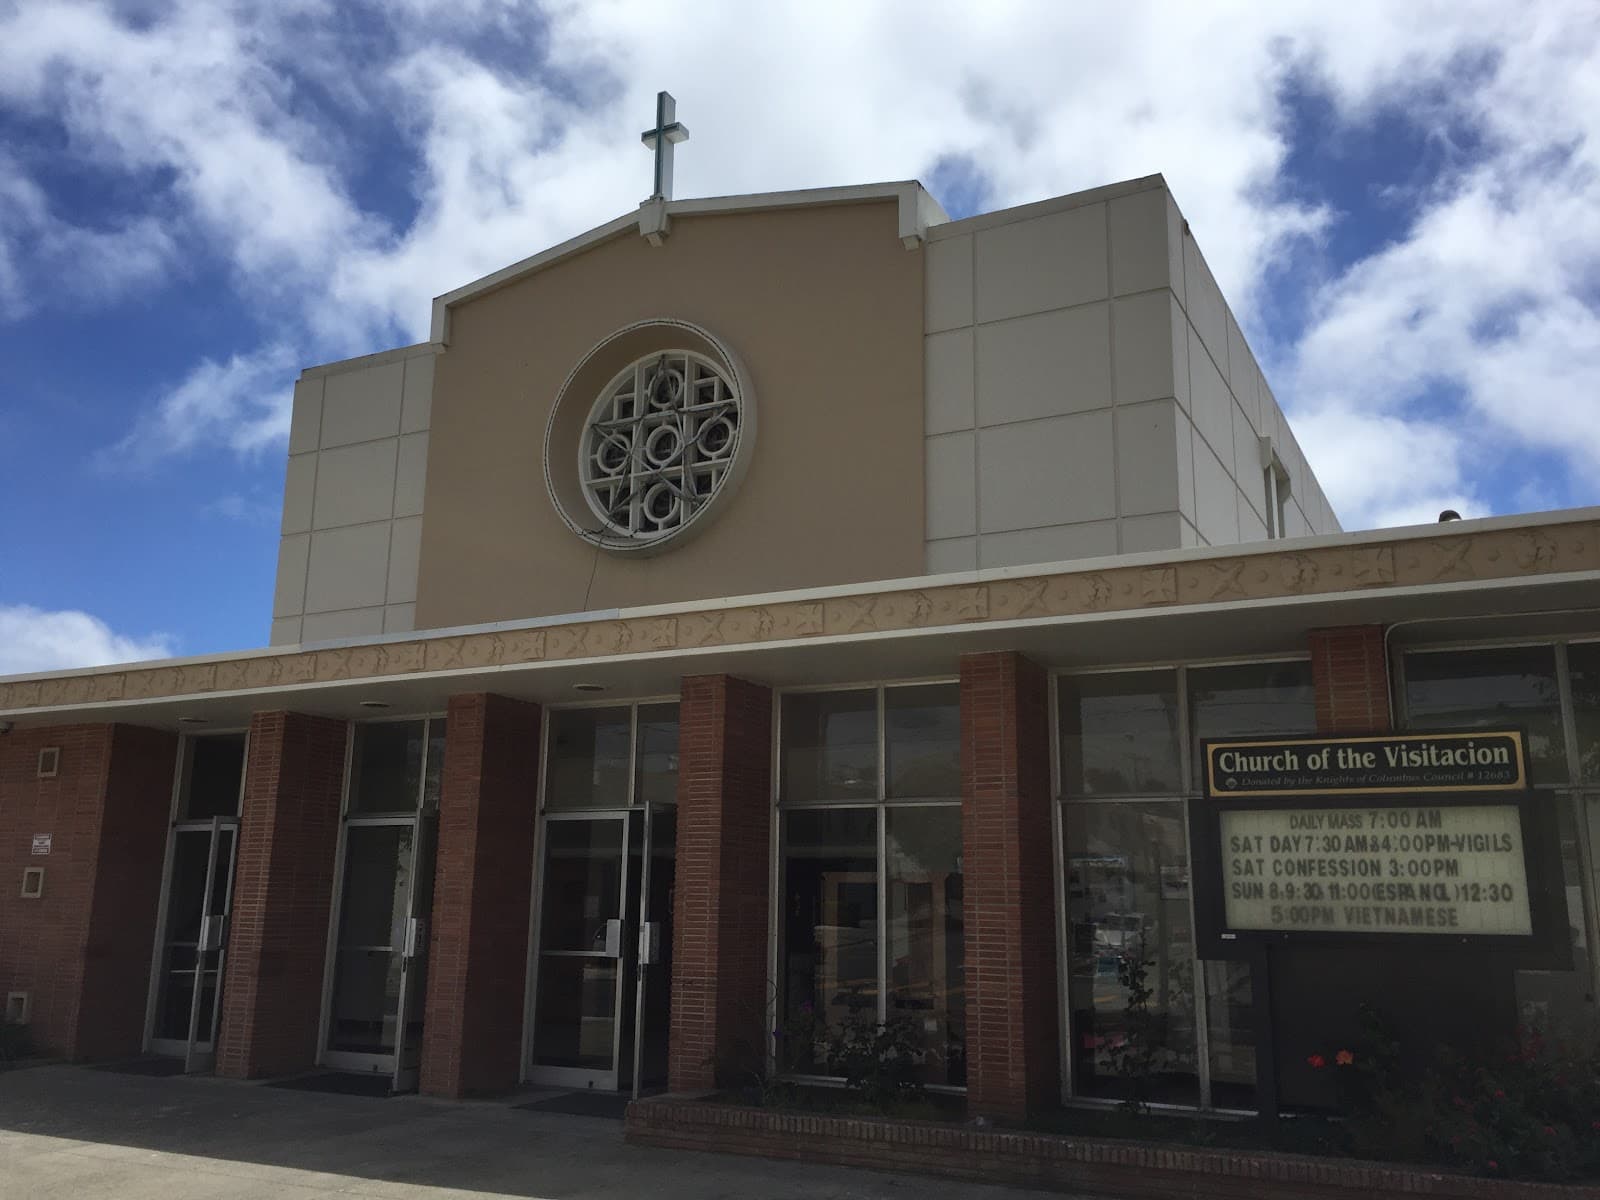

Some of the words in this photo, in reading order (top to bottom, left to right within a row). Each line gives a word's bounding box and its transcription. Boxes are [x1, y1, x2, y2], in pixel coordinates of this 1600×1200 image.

[1219, 750, 1300, 773] Church
[1306, 747, 1331, 770] of
[1337, 747, 1376, 769] the
[1384, 741, 1509, 768] Visitacion
[1241, 777, 1281, 786] Donated
[1284, 776, 1294, 786] by
[1297, 775, 1313, 785] the
[1315, 774, 1354, 785] Knights
[1356, 774, 1366, 784] of
[1368, 773, 1420, 783] Columbus
[1423, 770, 1464, 782] Council
[1289, 814, 1325, 830] DAILY
[1327, 813, 1362, 829] MASS
[1368, 810, 1410, 829] 7:00
[1415, 809, 1442, 828] AM
[1230, 835, 1263, 853] SAT
[1269, 835, 1301, 853] DAY
[1304, 835, 1341, 853] 7:30
[1232, 858, 1264, 876] SAT
[1272, 858, 1381, 877] CONFESSION
[1389, 858, 1459, 877] 3:00PM
[1231, 882, 1264, 900] SUN
[1271, 904, 1334, 924] 5:00PM
[1343, 905, 1459, 927] VIETNAMESE
